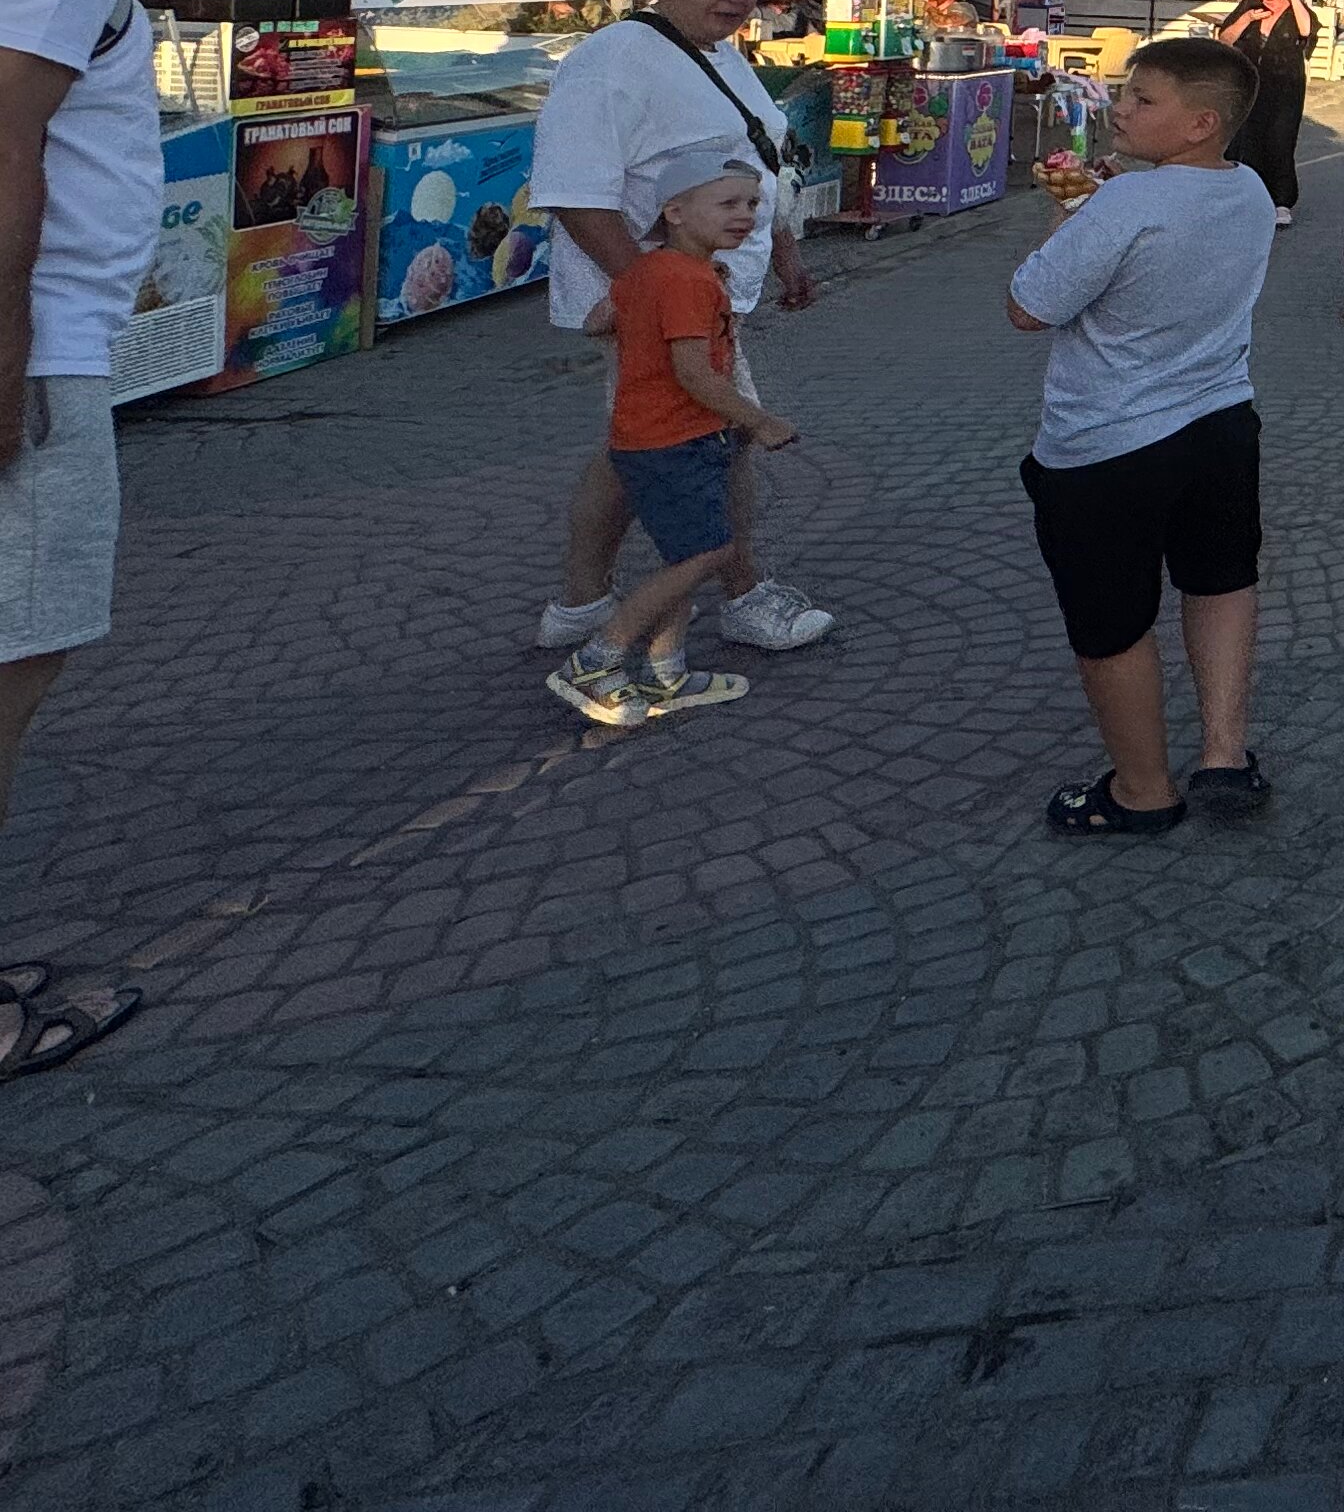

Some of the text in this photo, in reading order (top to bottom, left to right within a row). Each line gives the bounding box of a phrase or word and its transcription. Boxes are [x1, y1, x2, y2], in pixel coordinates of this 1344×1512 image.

[244, 116, 352, 146] ГРАНАТОВЫЙ СОК
[872, 185, 948, 203] ЗДЕСЬ!
